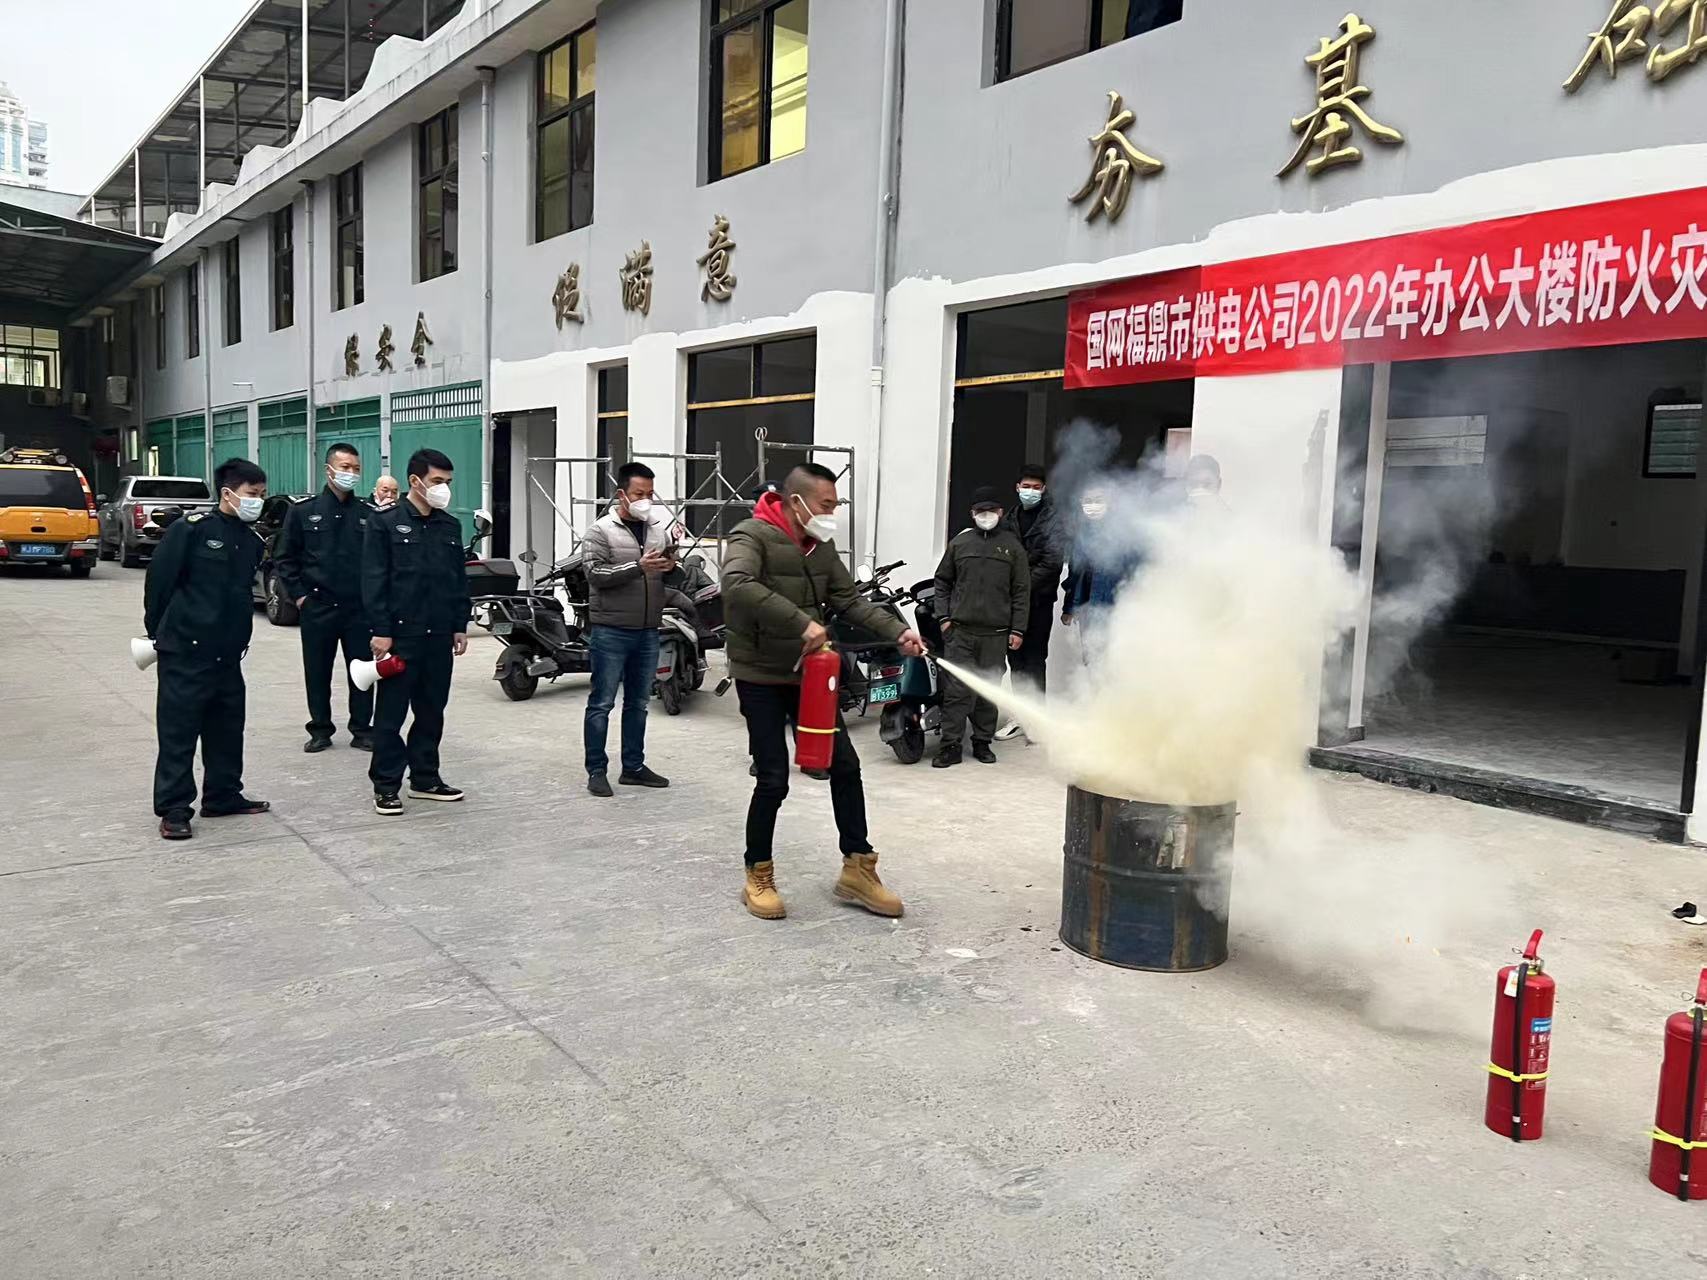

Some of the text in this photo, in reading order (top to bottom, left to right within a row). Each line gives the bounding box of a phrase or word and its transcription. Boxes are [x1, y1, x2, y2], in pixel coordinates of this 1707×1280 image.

[1086, 222, 1707, 371] 国网福鼎市供电公司2022年办公大楼防火灾
